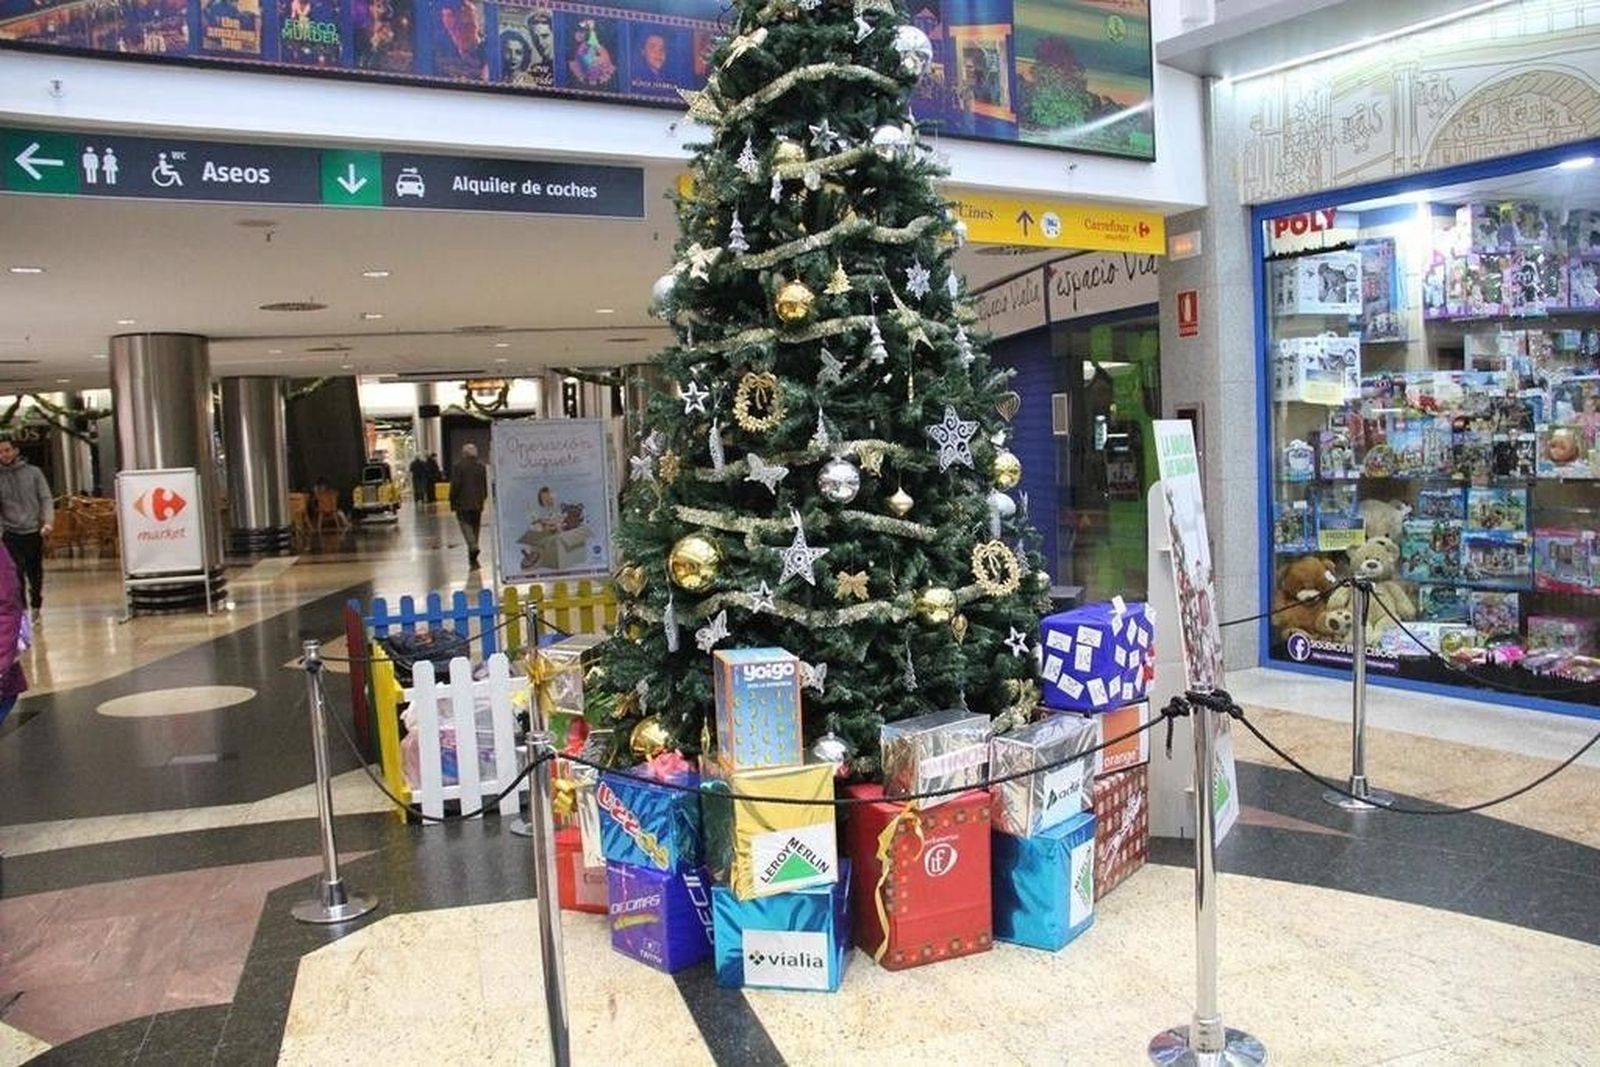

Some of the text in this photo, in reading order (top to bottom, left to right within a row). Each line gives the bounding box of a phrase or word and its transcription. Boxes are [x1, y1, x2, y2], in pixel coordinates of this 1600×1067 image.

[171, 151, 187, 161] WC
[201, 161, 272, 185] Aseos
[452, 175, 598, 199] Alquiler de coches
[958, 203, 994, 221] Cines
[1274, 206, 1338, 239] POLY
[137, 528, 186, 543] market
[743, 662, 795, 682] yoigo
[1103, 751, 1139, 769] orange
[760, 836, 830, 884] LEROY MERLIN
[768, 950, 824, 970] vialia
